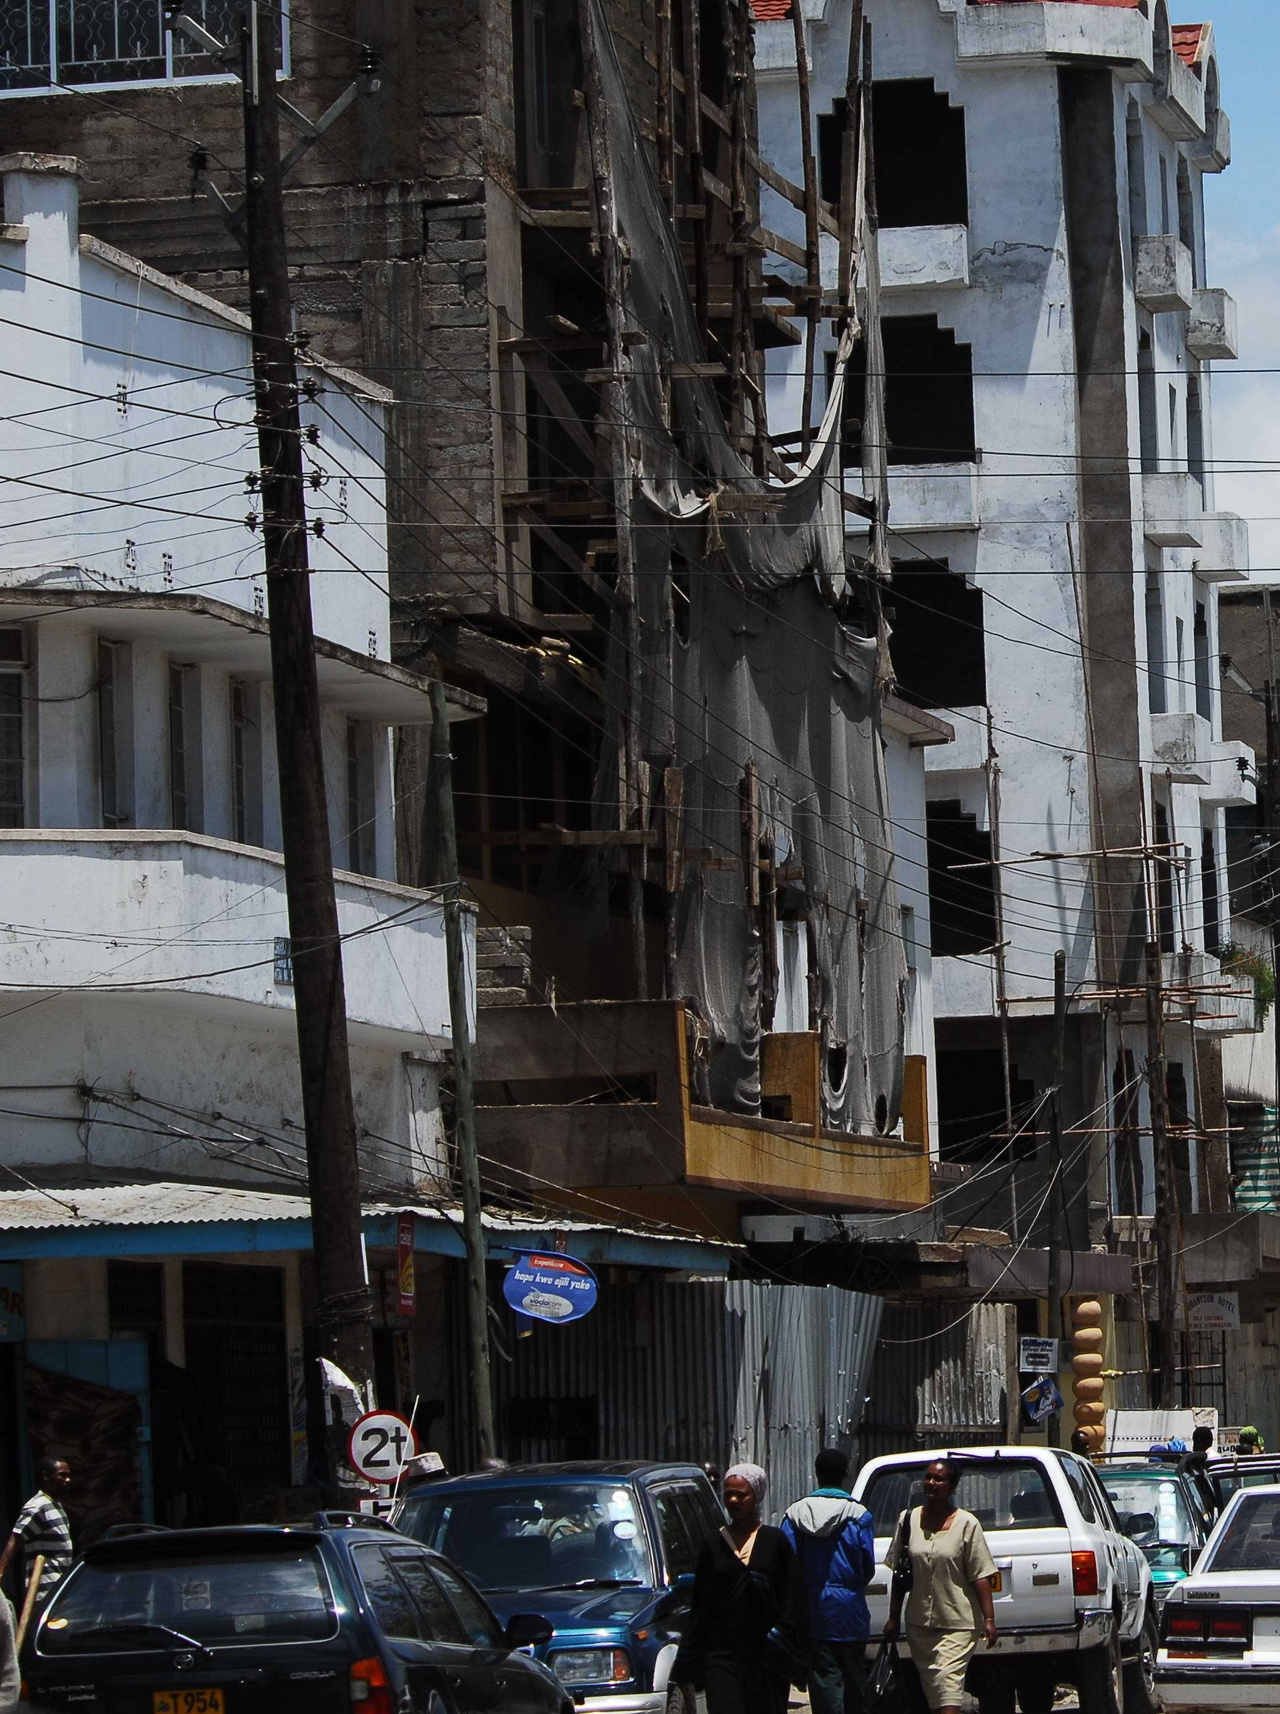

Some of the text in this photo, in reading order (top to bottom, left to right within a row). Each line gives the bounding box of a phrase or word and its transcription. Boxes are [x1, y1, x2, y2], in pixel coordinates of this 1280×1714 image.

[514, 1270, 534, 1284] hapa
[535, 1273, 553, 1285] kwa
[570, 1280, 591, 1290] yako
[530, 1298, 562, 1308] vodacom
[1217, 1295, 1236, 1314] HOTEL
[1022, 1338, 1054, 1348] Gillette
[1032, 1404, 1053, 1420] Gillette
[361, 1426, 409, 1469] 2t
[289, 1669, 337, 1680] COROLLA
